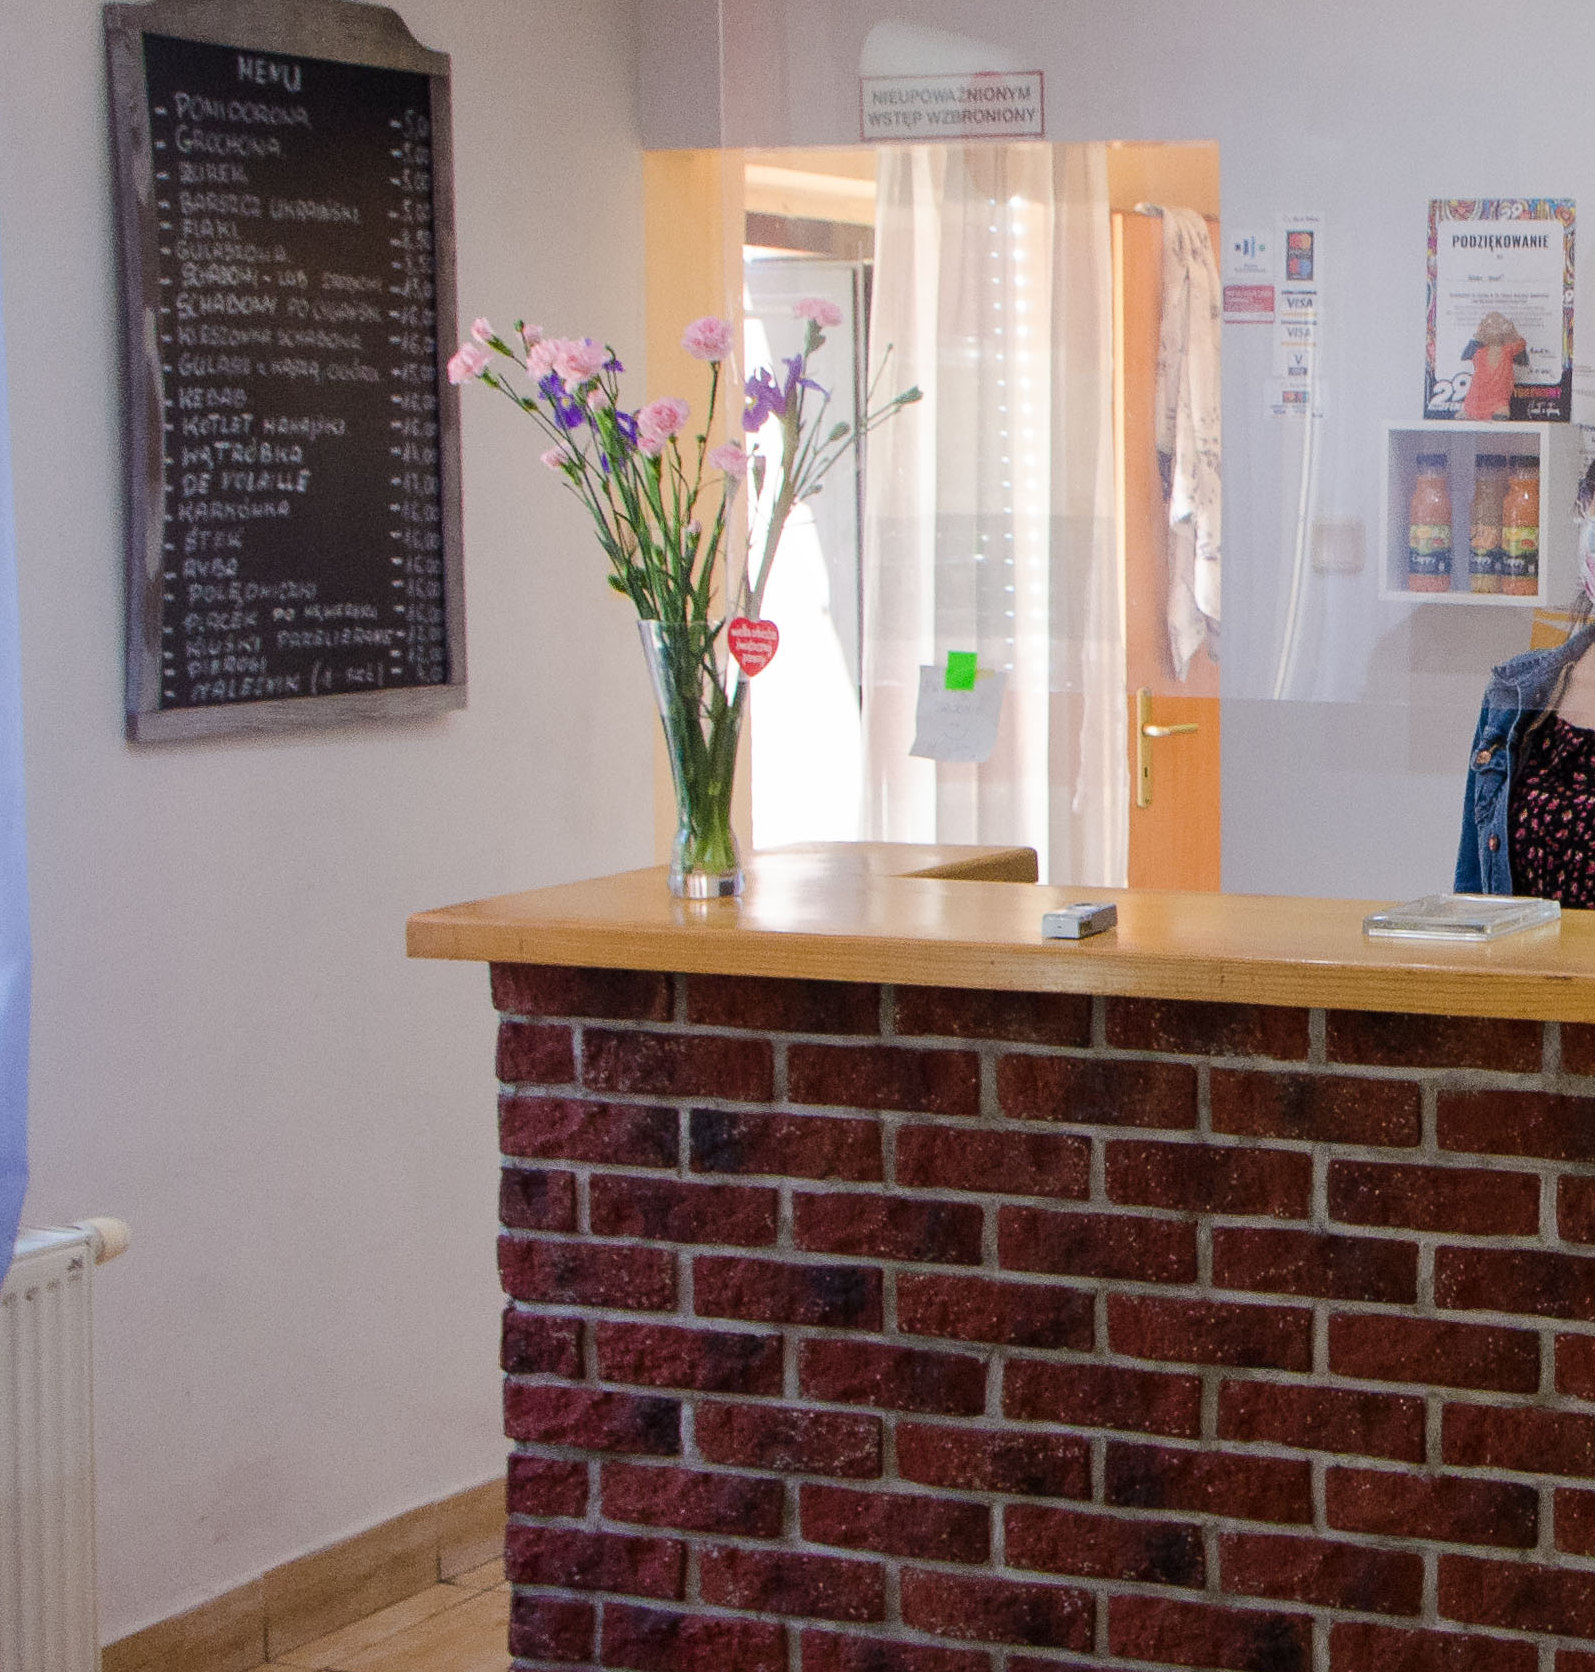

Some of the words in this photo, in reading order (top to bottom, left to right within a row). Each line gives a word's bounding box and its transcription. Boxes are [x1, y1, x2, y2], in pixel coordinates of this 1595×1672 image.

[236, 55, 303, 93] MENU
[867, 110, 924, 127] WSTĘP
[926, 107, 1036, 125] WZBRONIONY
[1451, 234, 1549, 252] PODZIĘKOWANIE
